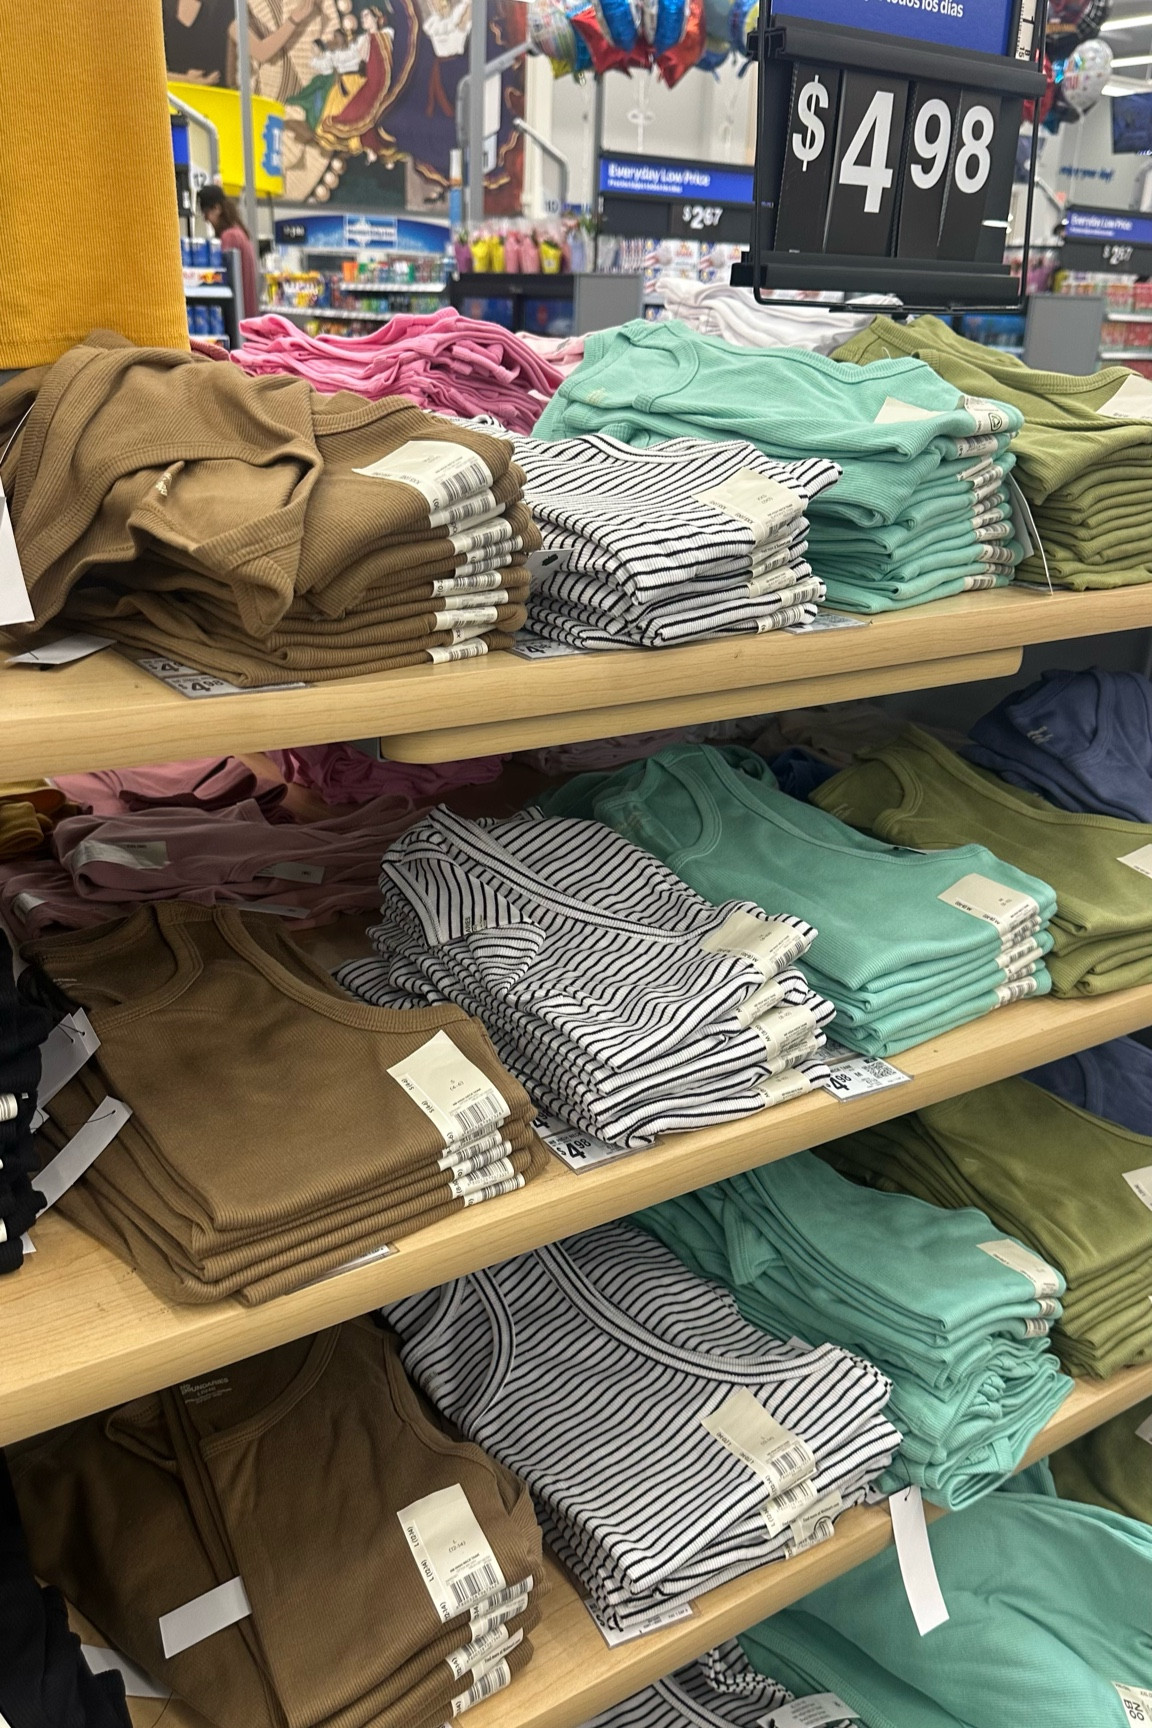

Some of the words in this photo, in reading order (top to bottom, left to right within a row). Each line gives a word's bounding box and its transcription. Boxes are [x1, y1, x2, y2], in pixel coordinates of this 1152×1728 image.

[921, 0, 938, 12] los
[940, 0, 963, 17] días
[608, 163, 660, 182] Everyday
[662, 169, 683, 183] Low
[684, 170, 710, 187] Price
